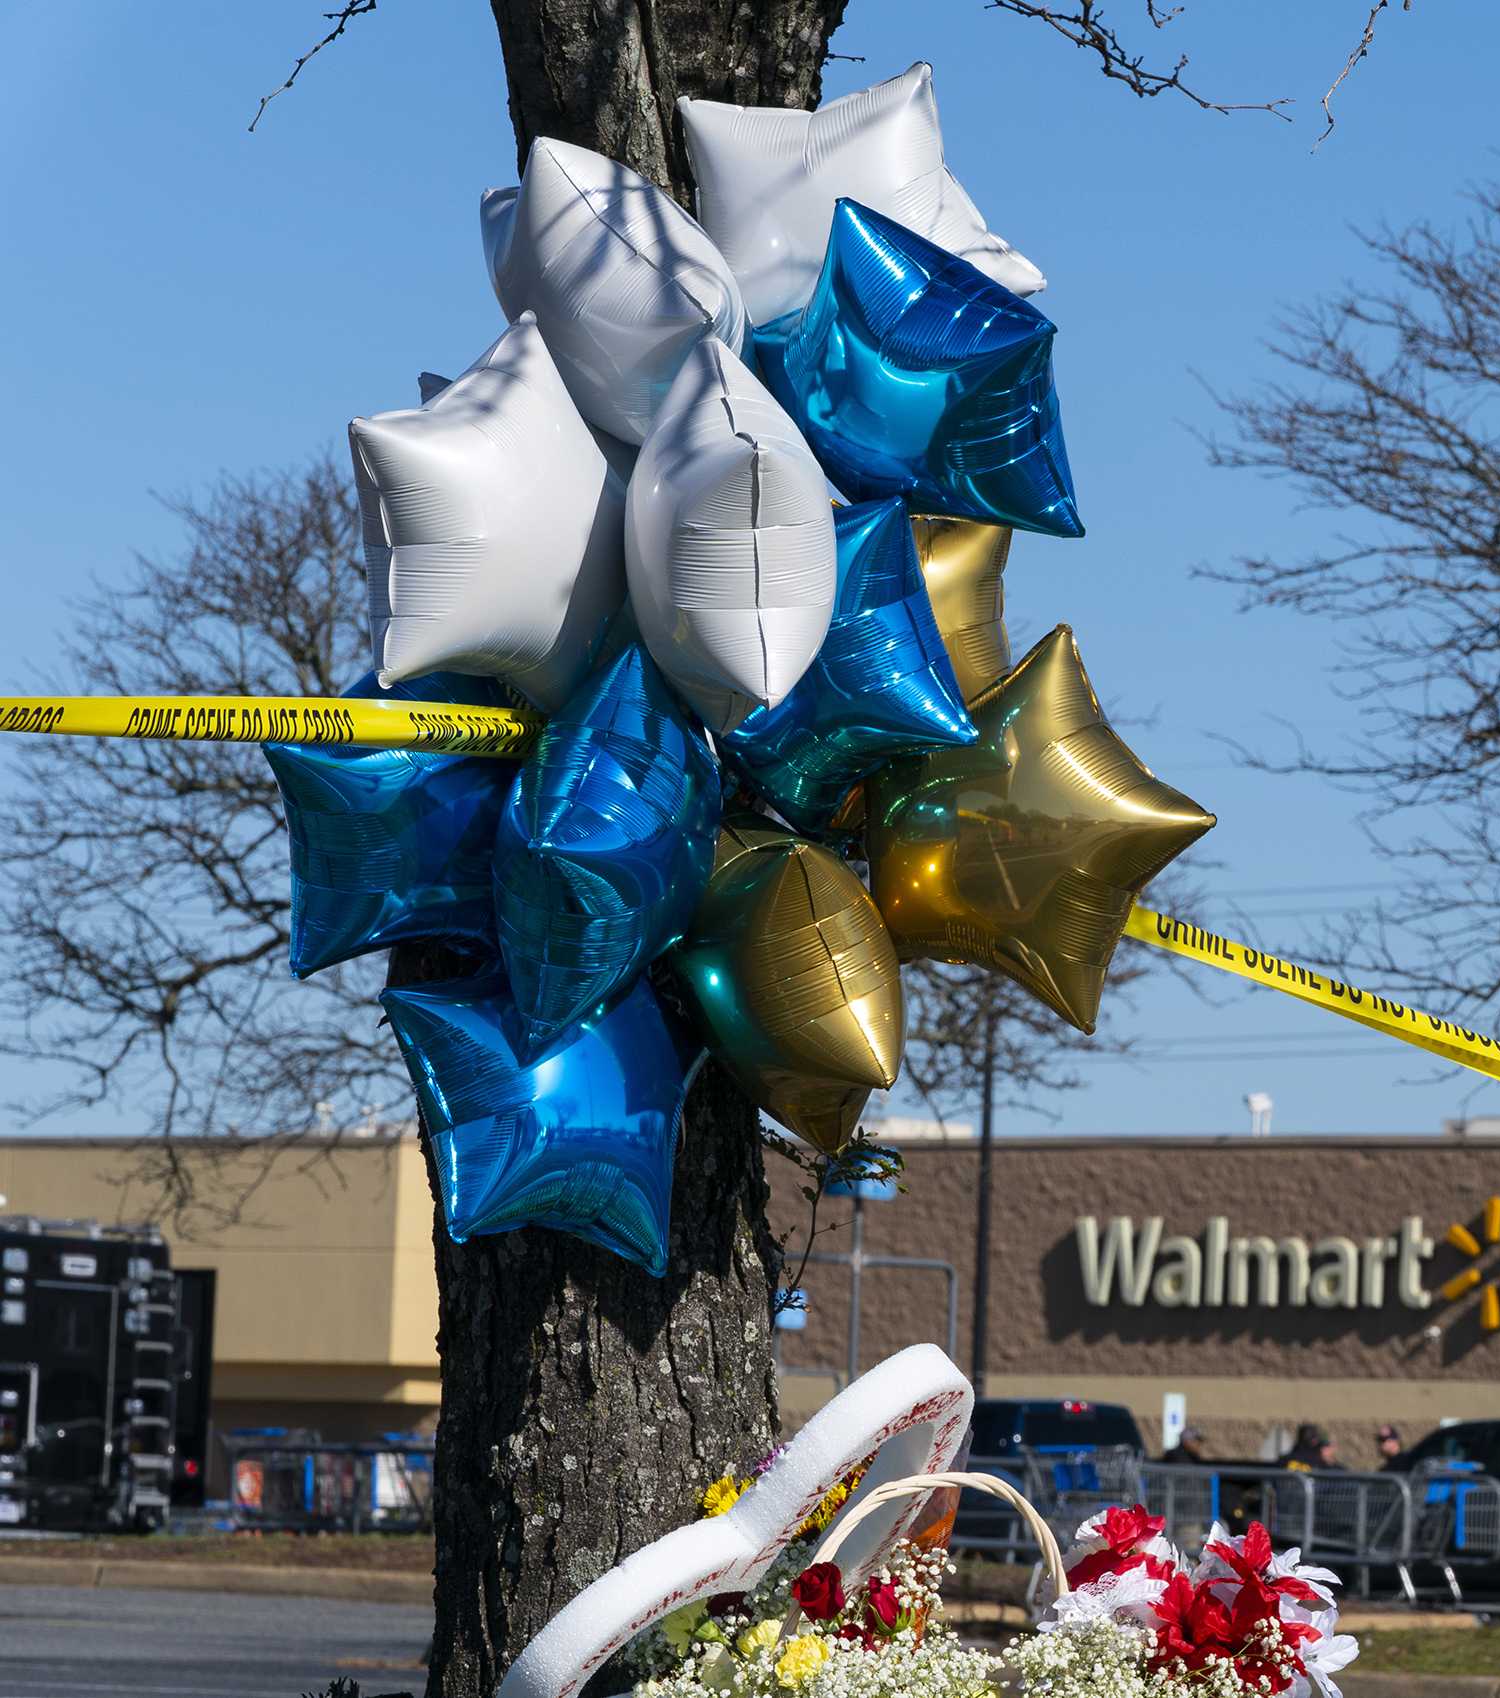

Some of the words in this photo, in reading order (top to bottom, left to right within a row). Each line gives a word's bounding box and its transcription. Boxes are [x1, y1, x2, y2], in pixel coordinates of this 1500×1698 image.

[122, 707, 182, 738] CRIME
[184, 707, 236, 739] SCENE
[238, 708, 263, 741] DO
[266, 708, 298, 742] NOT
[301, 708, 355, 743] CROSS
[1075, 1214, 1435, 1309] Walmart
